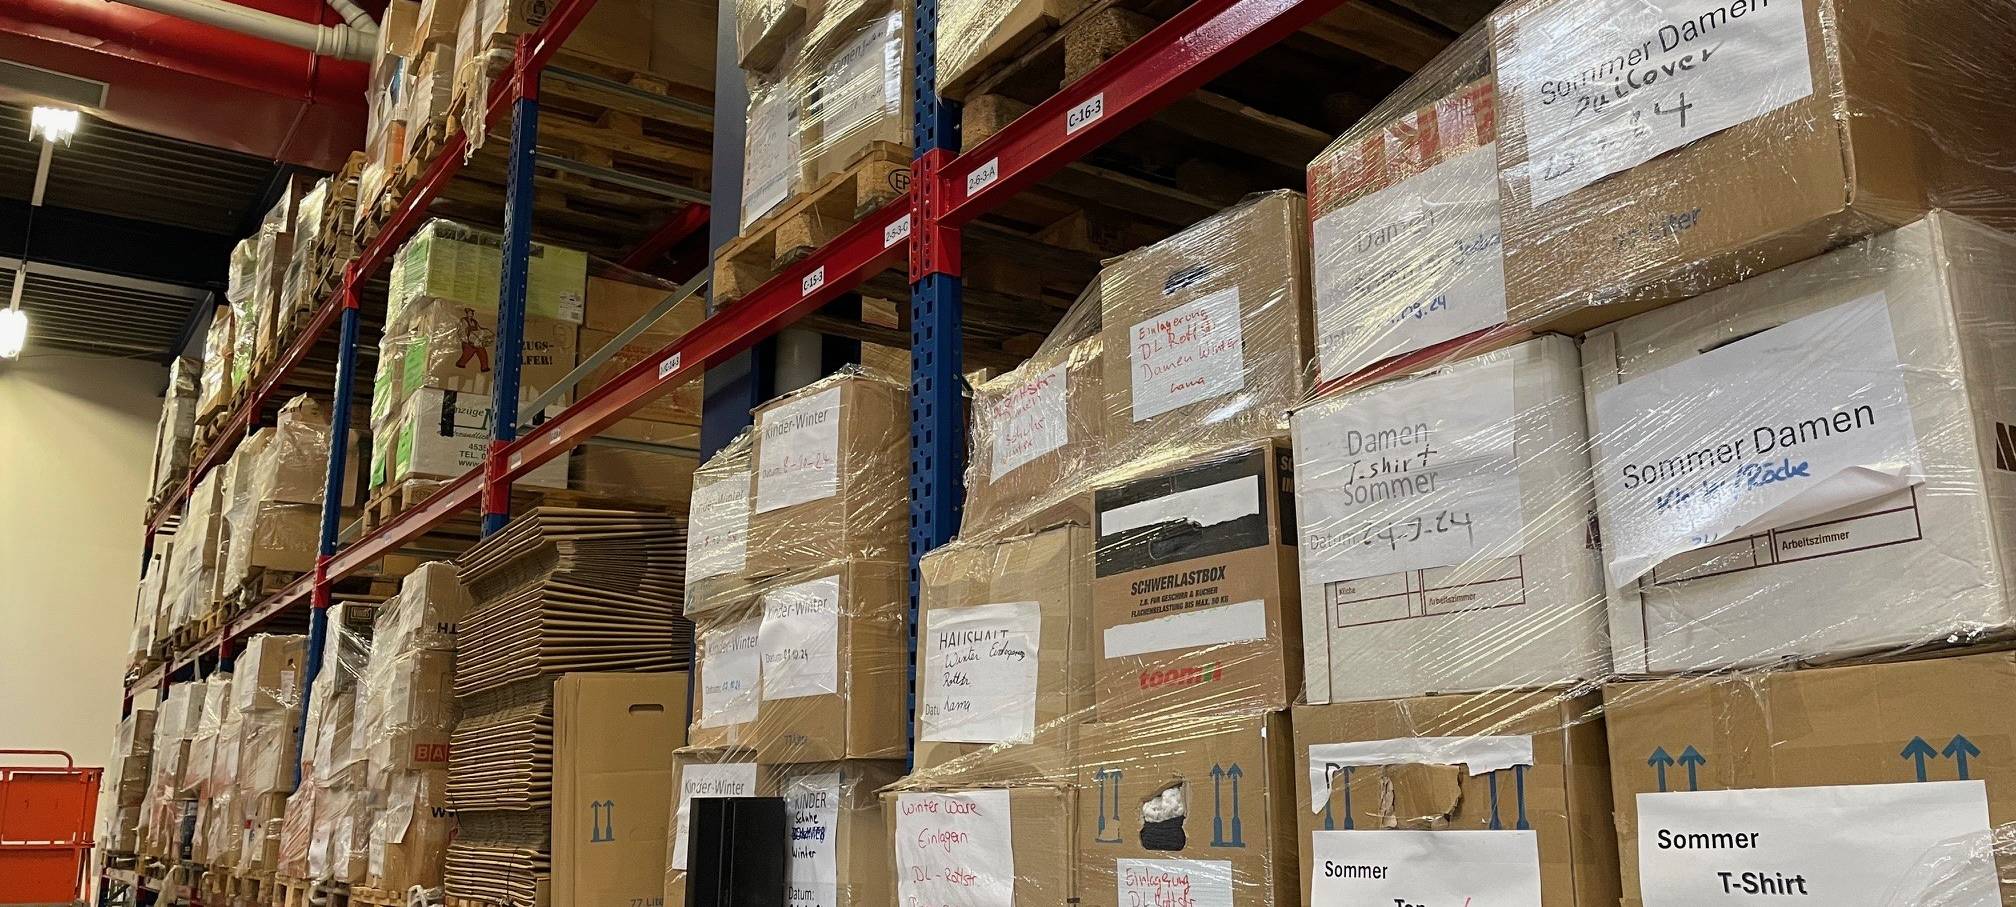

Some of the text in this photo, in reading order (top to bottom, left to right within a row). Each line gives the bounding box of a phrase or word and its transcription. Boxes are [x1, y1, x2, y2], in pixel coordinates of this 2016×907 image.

[1541, 39, 1651, 105] Sommer
[1068, 100, 1101, 127] C-16-3
[968, 166, 996, 190] 2-6-3-A
[803, 270, 823, 292] C-15-3
[764, 408, 829, 440] Kinder-Winter
[1346, 422, 1428, 457] Damen
[1622, 402, 1875, 491] Sommer Damen
[459, 450, 478, 459] TEL.
[1343, 470, 1438, 507] Sommer
[1781, 529, 1851, 552] Arbeitszimmer
[1130, 565, 1227, 597] SCHWERLASTBOX
[766, 598, 828, 620] Kinder-Winter
[684, 780, 745, 796] Kinder-Winter
[794, 792, 827, 810] KINDER
[902, 800, 983, 817] Winter Ware
[1657, 829, 1760, 850] Sommer
[791, 846, 817, 859] Winter
[1324, 860, 1388, 880] Sommer
[788, 886, 815, 900] Datum:
[1717, 871, 1809, 896] T-Shirt
